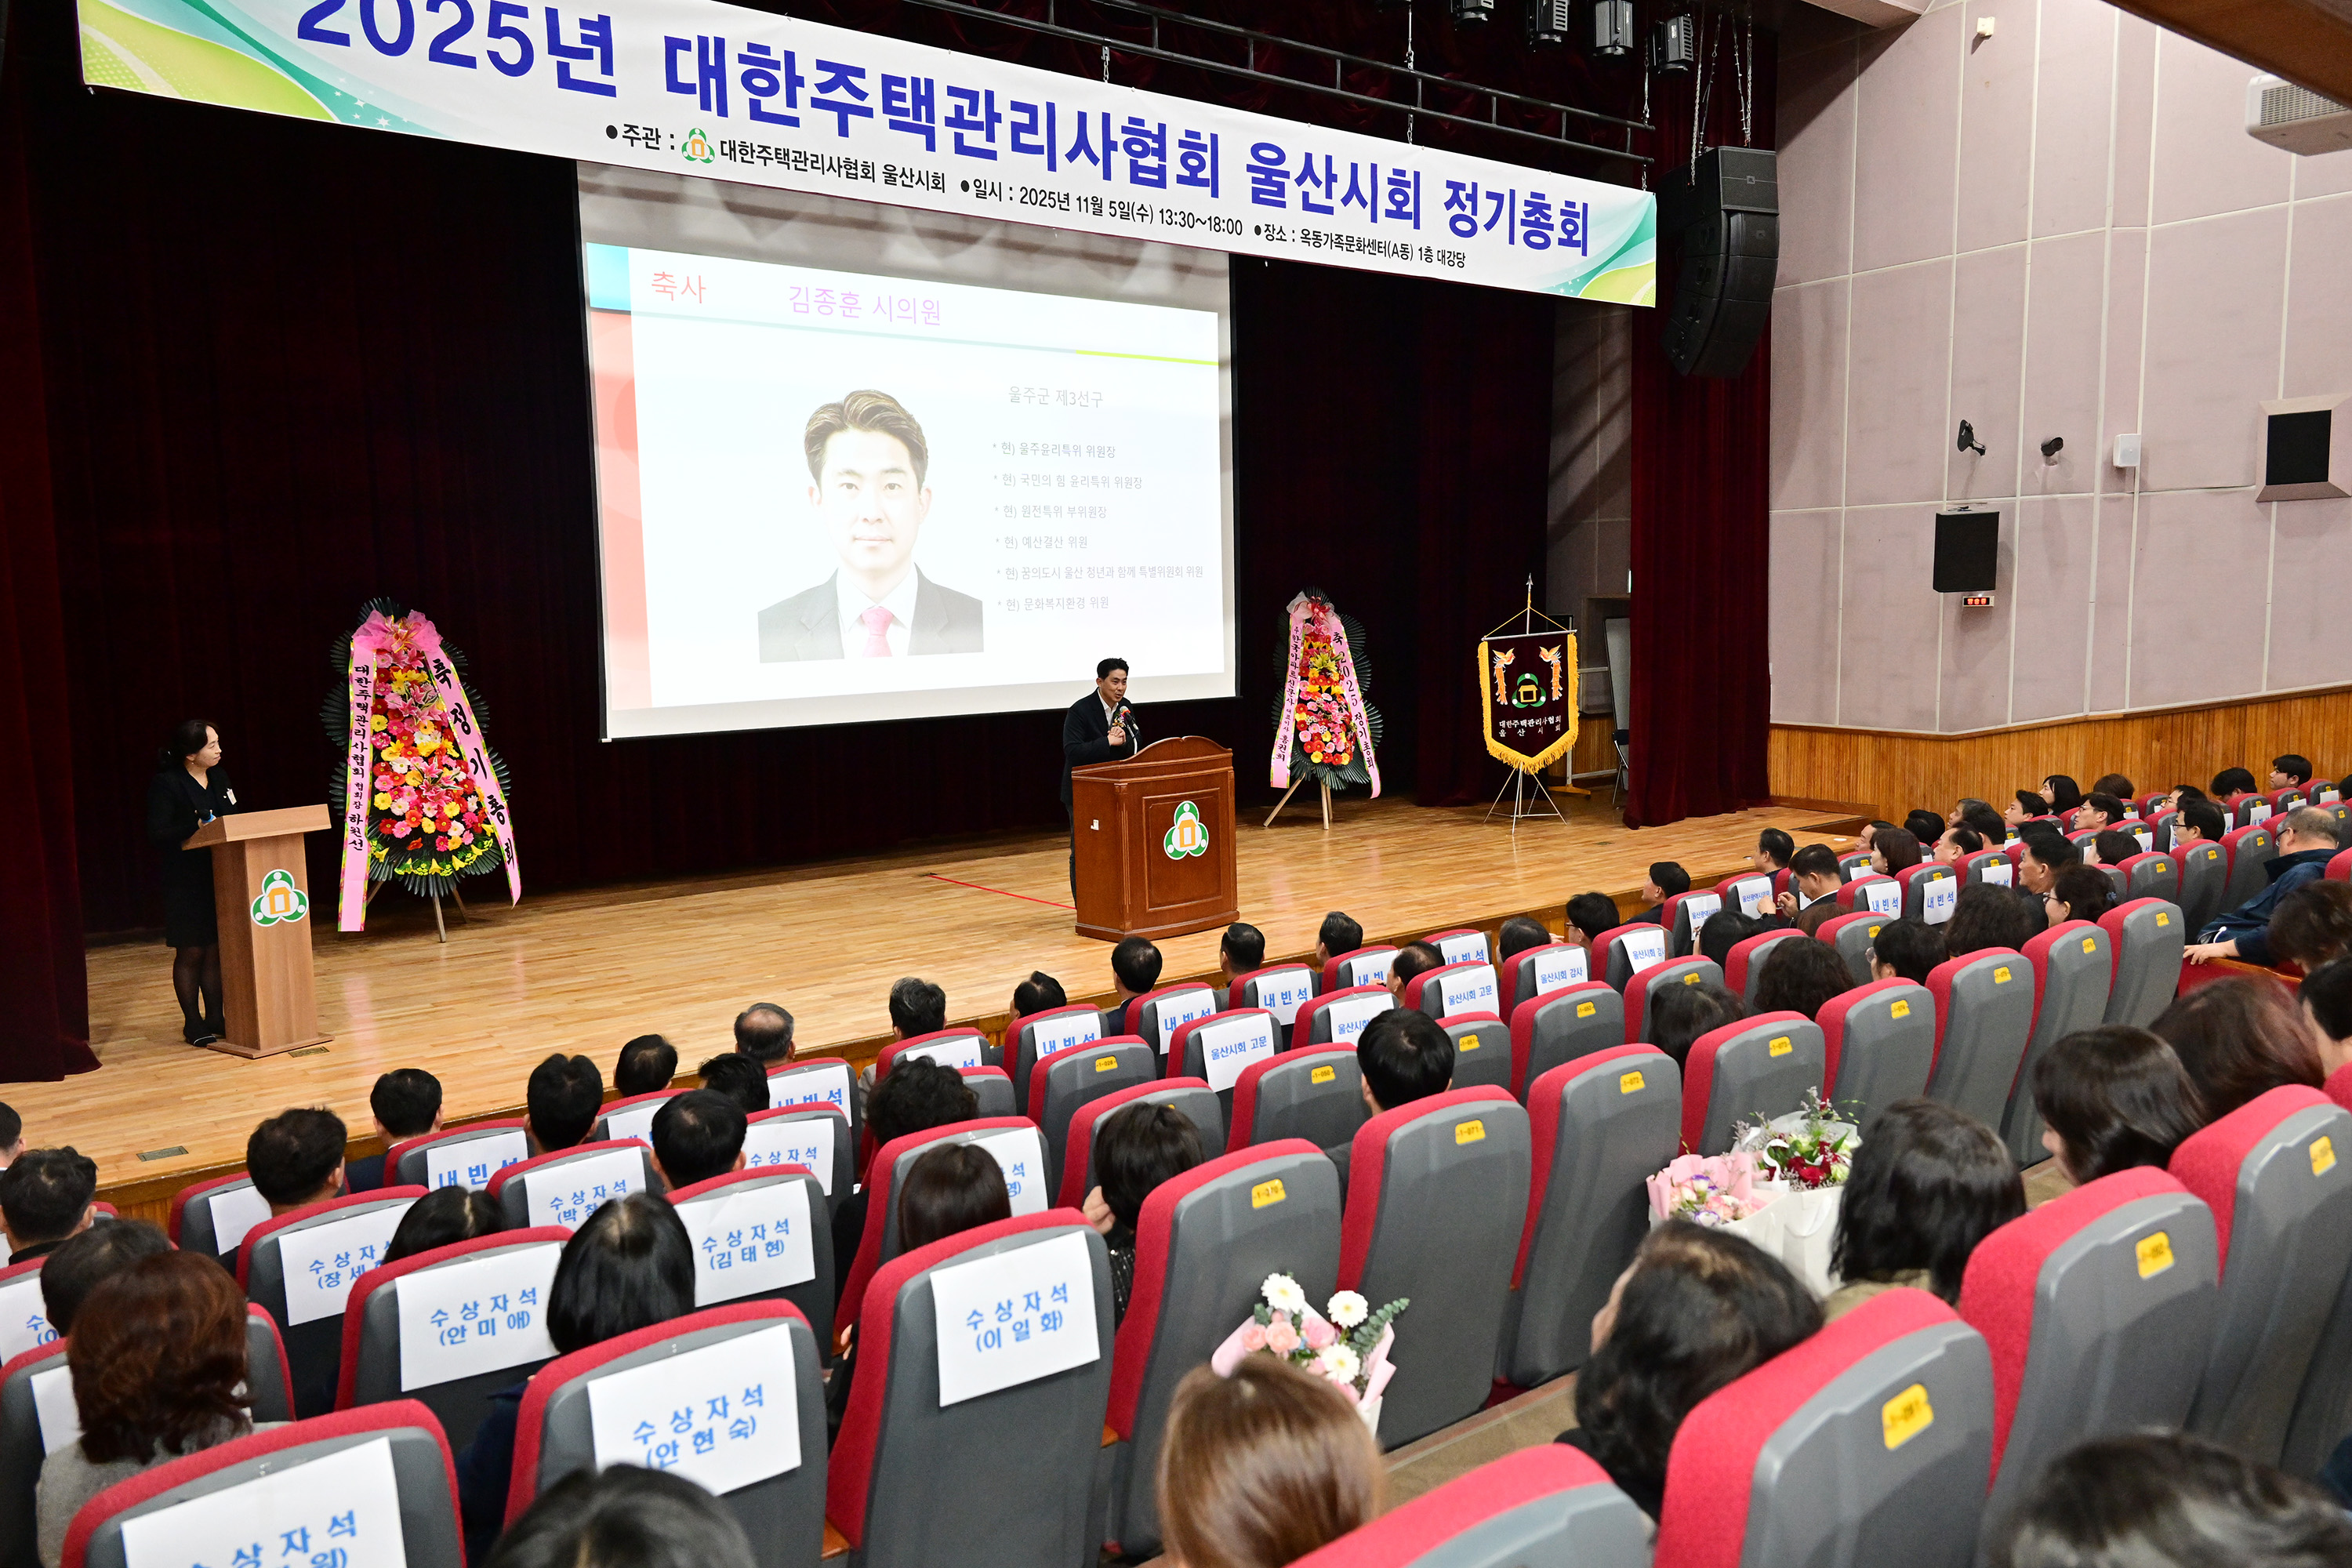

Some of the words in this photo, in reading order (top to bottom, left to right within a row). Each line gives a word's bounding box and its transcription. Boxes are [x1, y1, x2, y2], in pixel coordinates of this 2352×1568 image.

[297, 0, 616, 98] 2025년
[663, 34, 1221, 199] 대한주택관리사협회
[1246, 142, 1421, 230] 울산시회
[1443, 178, 1589, 256] 정기총회
[622, 123, 662, 151] 주관
[720, 139, 876, 184] 대한주택관리사협회
[882, 164, 946, 194] 울산시회
[972, 178, 1003, 202] 일시
[1019, 187, 1071, 212] 2025년
[1076, 195, 1104, 217] 11월
[1109, 200, 1154, 225] 5일(수)
[1159, 208, 1243, 236] 13:30~18:00
[1264, 223, 1287, 243] 장소
[1300, 228, 1414, 262] 옥동가족문화센터(A동)
[1417, 245, 1434, 263] 1층
[1436, 249, 1466, 269] 대강당
[651, 270, 706, 304] 축사
[789, 285, 862, 319] 김종훈
[872, 295, 941, 326] 시의원
[1008, 386, 1051, 406] 울주군
[1055, 389, 1104, 408] 제3선구
[1019, 442, 1081, 457] 울주윤리특위
[1086, 445, 1116, 459] 위원장
[1020, 474, 1051, 487] 국민의
[1056, 474, 1065, 488] 힘
[1069, 475, 1110, 488] 윤리특위
[1114, 476, 1142, 489] 위원장
[1022, 505, 1062, 518] 원전특위
[1066, 506, 1107, 519] 부위원장
[1022, 536, 1063, 549] 예산결산
[1068, 536, 1087, 549] 위원
[1021, 567, 1061, 580] 꿈의도시
[1064, 566, 1083, 579] 울산
[1087, 566, 1115, 579] 청년과
[1117, 566, 1136, 579] 함께
[1138, 565, 1183, 579] 특별위원회
[1186, 565, 1203, 578] 위원
[1023, 597, 1085, 611] 문화복지환경
[1090, 596, 1109, 609] 위원
[352, 665, 372, 779] 대한주택관리사협회
[1499, 715, 1561, 728] 대한주택관리사협회
[353, 782, 363, 810] 협회장
[1872, 897, 1899, 913] 내빈석
[1927, 891, 1955, 909] 내빈석
[1358, 971, 1384, 985] 내빈
[1541, 971, 1567, 984] 울산시회
[1570, 967, 1582, 978] 감사
[1264, 988, 1308, 1008] 내빈석
[1448, 993, 1475, 1006] 울산시회
[1479, 985, 1493, 997] 고문
[1210, 1042, 1247, 1061] 울산시회
[1250, 1036, 1267, 1050] 고문
[750, 1146, 817, 1167] 수상자석
[550, 1179, 626, 1210] 수상자석
[702, 1218, 790, 1254] 수상자석
[310, 1240, 390, 1274] 수상자
[710, 1240, 785, 1271] (김태현)
[430, 1287, 538, 1328] 수상자석
[966, 1282, 1069, 1330] 수상자석
[439, 1311, 531, 1346] (안미애)
[975, 1310, 1063, 1353] (이일화)
[633, 1383, 764, 1445] 수상자석
[647, 1415, 757, 1469] (안현숙)
[191, 1510, 356, 1568] 상자석
